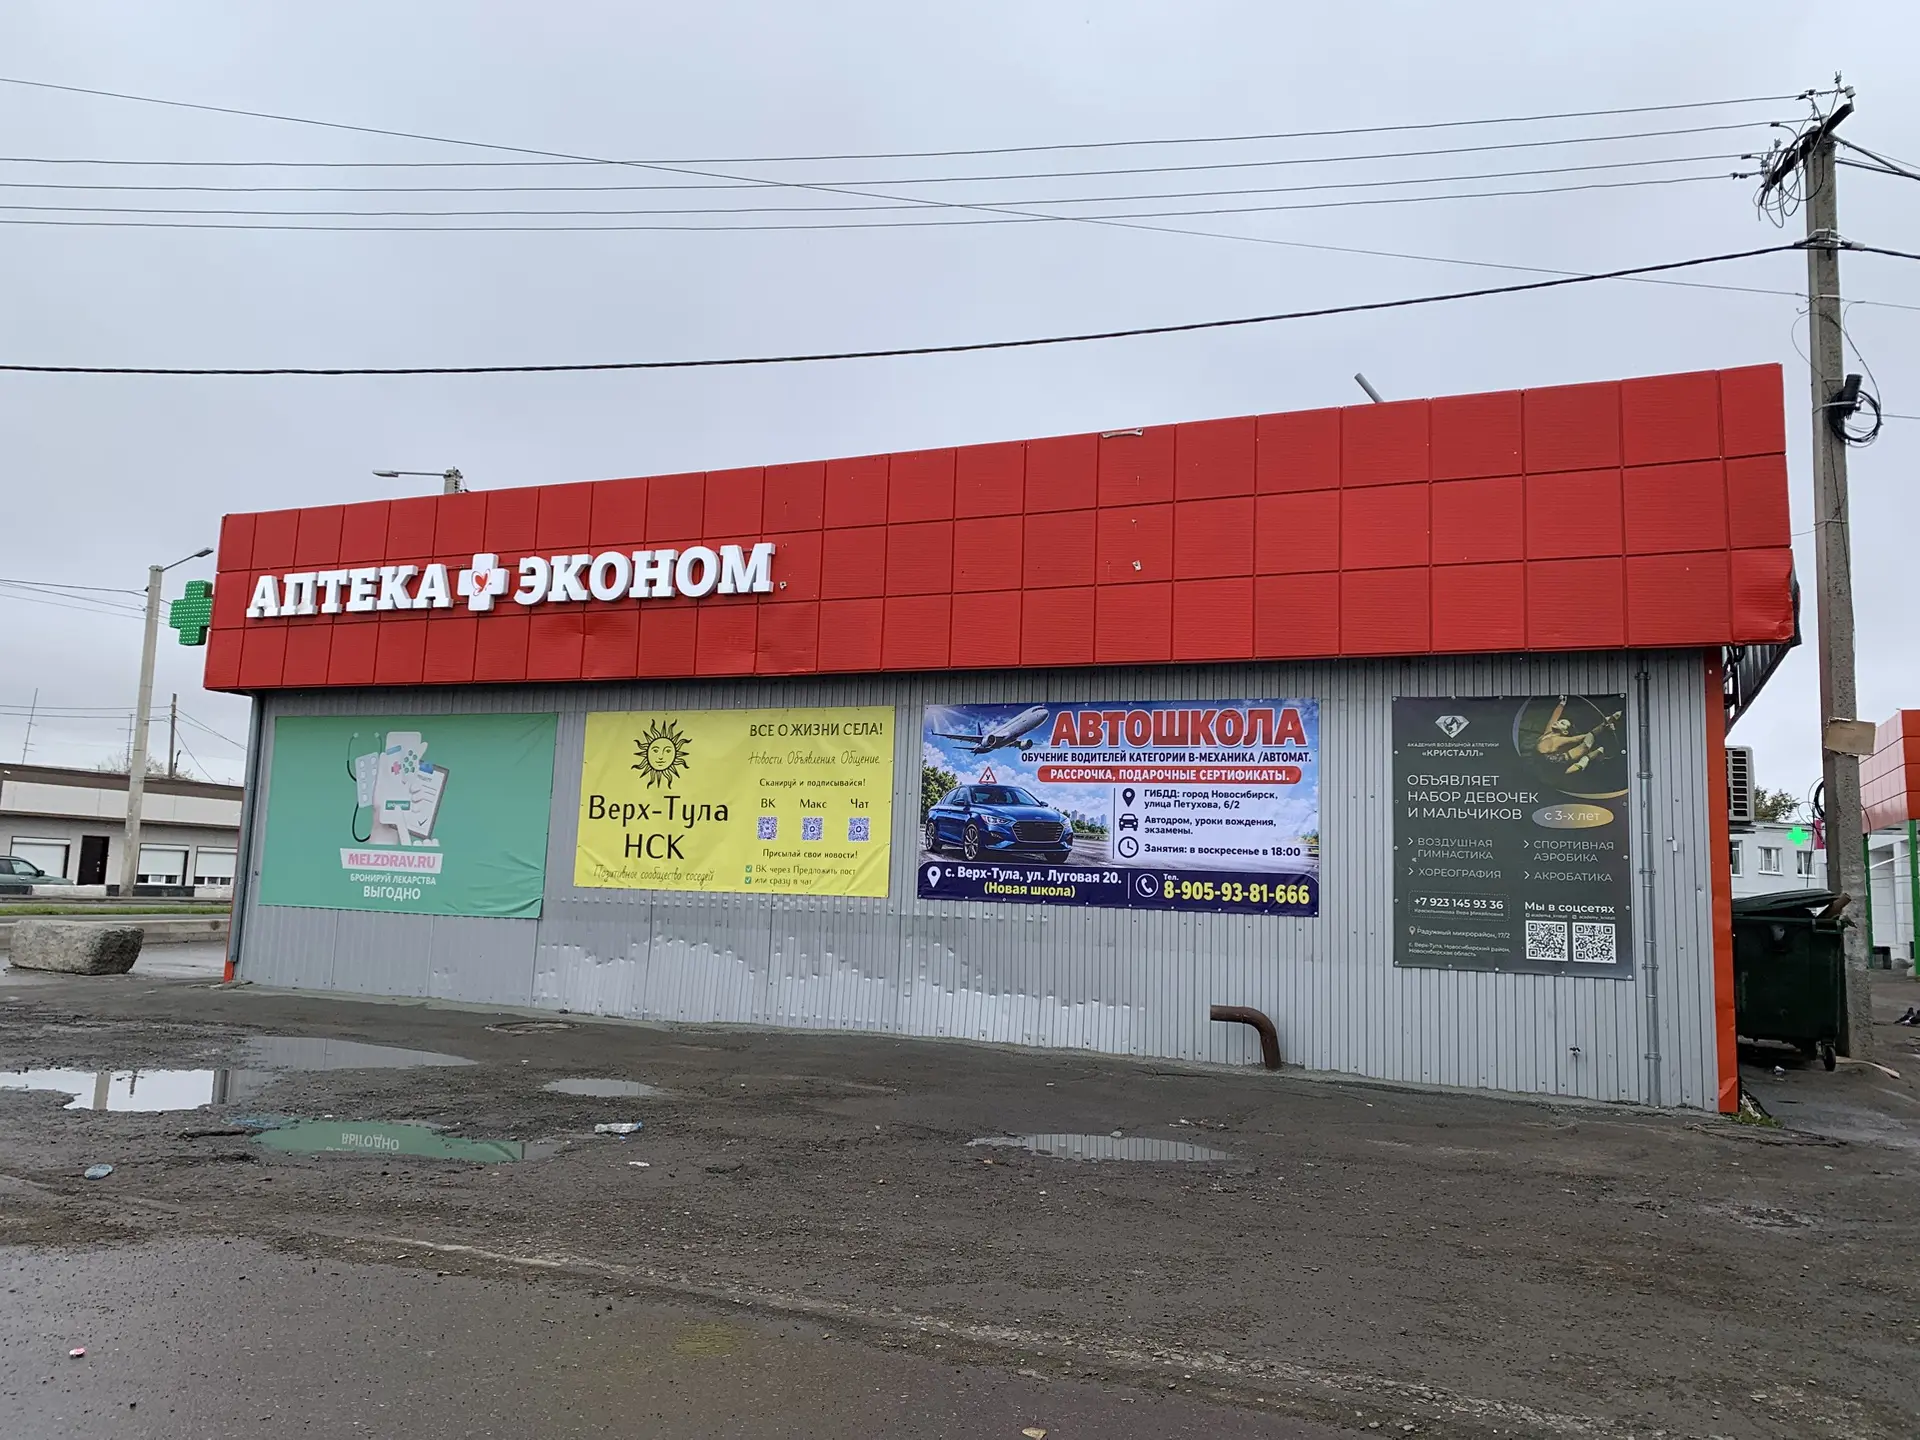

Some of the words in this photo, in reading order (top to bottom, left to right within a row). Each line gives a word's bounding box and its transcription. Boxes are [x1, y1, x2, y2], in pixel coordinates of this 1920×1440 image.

[246, 563, 454, 618] АПТЕКА
[513, 543, 776, 605] ЭКОНОМ
[750, 724, 774, 736] ВСЕ
[778, 724, 788, 736] О
[790, 723, 839, 736] ЖИЗНИ
[843, 722, 883, 736] СЕЛА!
[1050, 708, 1308, 748] АВТОШКОЛА
[748, 751, 782, 764] Новости
[787, 750, 836, 764] Объявления
[841, 750, 880, 766] Общение
[1021, 752, 1069, 762] ОБУЧЕНИЕ
[1071, 750, 1127, 763] ВОДИТЕЛЕЙ
[1129, 752, 1186, 762] КАТЕГОРИИ
[1188, 752, 1255, 763] В-МЕХАНИКА
[1257, 751, 1312, 763] /АВТОМАТ.
[1422, 749, 1484, 757] «КРИСТАЛЛ»
[1050, 769, 1116, 781] РАССРОЧКА,
[1119, 769, 1197, 781] ПОДАРОЧНЫЕ
[1200, 769, 1290, 781] СЕРТИФИКАТЫ.
[1407, 774, 1499, 786] ОБЪЯВЛЯЕТ
[759, 778, 796, 788] Сканируй
[807, 778, 866, 787] подписывайся!
[1144, 789, 1180, 799] ГИБДД:
[1182, 791, 1209, 799] город
[1211, 789, 1279, 800] Новосибирск,
[1408, 791, 1461, 802] НАБОР
[1464, 792, 1539, 804] ДЕВОЧЕК
[761, 798, 776, 808] ВК
[800, 798, 827, 809] Макс
[850, 798, 869, 809] Чат
[1144, 801, 1171, 809] улица
[1174, 800, 1221, 810] Петухова,
[1223, 800, 1240, 809] 6/2
[588, 794, 728, 828] Верх-Тула
[1408, 807, 1418, 818] И
[1423, 807, 1522, 820] МАЛЬЧИКОВ
[1544, 812, 1552, 821] с
[1555, 810, 1575, 821] 3-х
[1577, 812, 1600, 821] лет
[1144, 816, 1192, 825] Автодром,
[1195, 818, 1223, 826] уроки
[1225, 818, 1277, 827] вождения,
[1144, 827, 1193, 835] экзамены.
[625, 833, 685, 860] НСК
[1417, 838, 1493, 848] ВОЗДУШНАЯ
[1533, 840, 1614, 850] СПОРТИВНАЯ
[762, 848, 800, 858] Присылай
[824, 850, 858, 859] новости!
[1144, 844, 1187, 853] Занятия:
[1198, 847, 1259, 856] воскресенье
[1271, 847, 1301, 856] 18:00
[1417, 850, 1493, 860] ГИМНАСТИКА
[348, 853, 436, 869] MELZDRAV.RU
[1534, 853, 1598, 862] АЭРОБИКА
[593, 864, 637, 882] Позитивное
[640, 866, 682, 881] сообщество
[686, 869, 715, 885] соседей
[755, 865, 767, 873] ВК
[770, 867, 791, 875] через
[793, 866, 837, 875] Предложить
[945, 868, 955, 877] с.
[957, 866, 1023, 882] Верх-Тула,
[1026, 872, 1045, 883] ул.
[1047, 870, 1100, 883] Луговая
[1102, 872, 1122, 884] 20.
[1419, 868, 1501, 879] ХОРЕОГРАФИЯ
[350, 873, 391, 883] БРОНИРУЙ
[392, 875, 436, 885] ЛЕКАРСТВА
[769, 878, 791, 886] сразу
[1163, 873, 1179, 881] Тел.
[1534, 872, 1613, 882] АКРОБАТИКА
[363, 885, 421, 901] ВЫГОДНО
[984, 882, 1027, 895] (Новая
[1030, 885, 1076, 898] школа)
[1163, 881, 1310, 904] 8-905-93-81-666
[1414, 897, 1427, 906] +7
[1429, 898, 1450, 907] 923
[1452, 899, 1471, 908] 145
[1473, 899, 1487, 909] 93
[1489, 900, 1504, 909] 36
[1524, 901, 1545, 911] Мы
[1558, 904, 1615, 913] соцсетях
